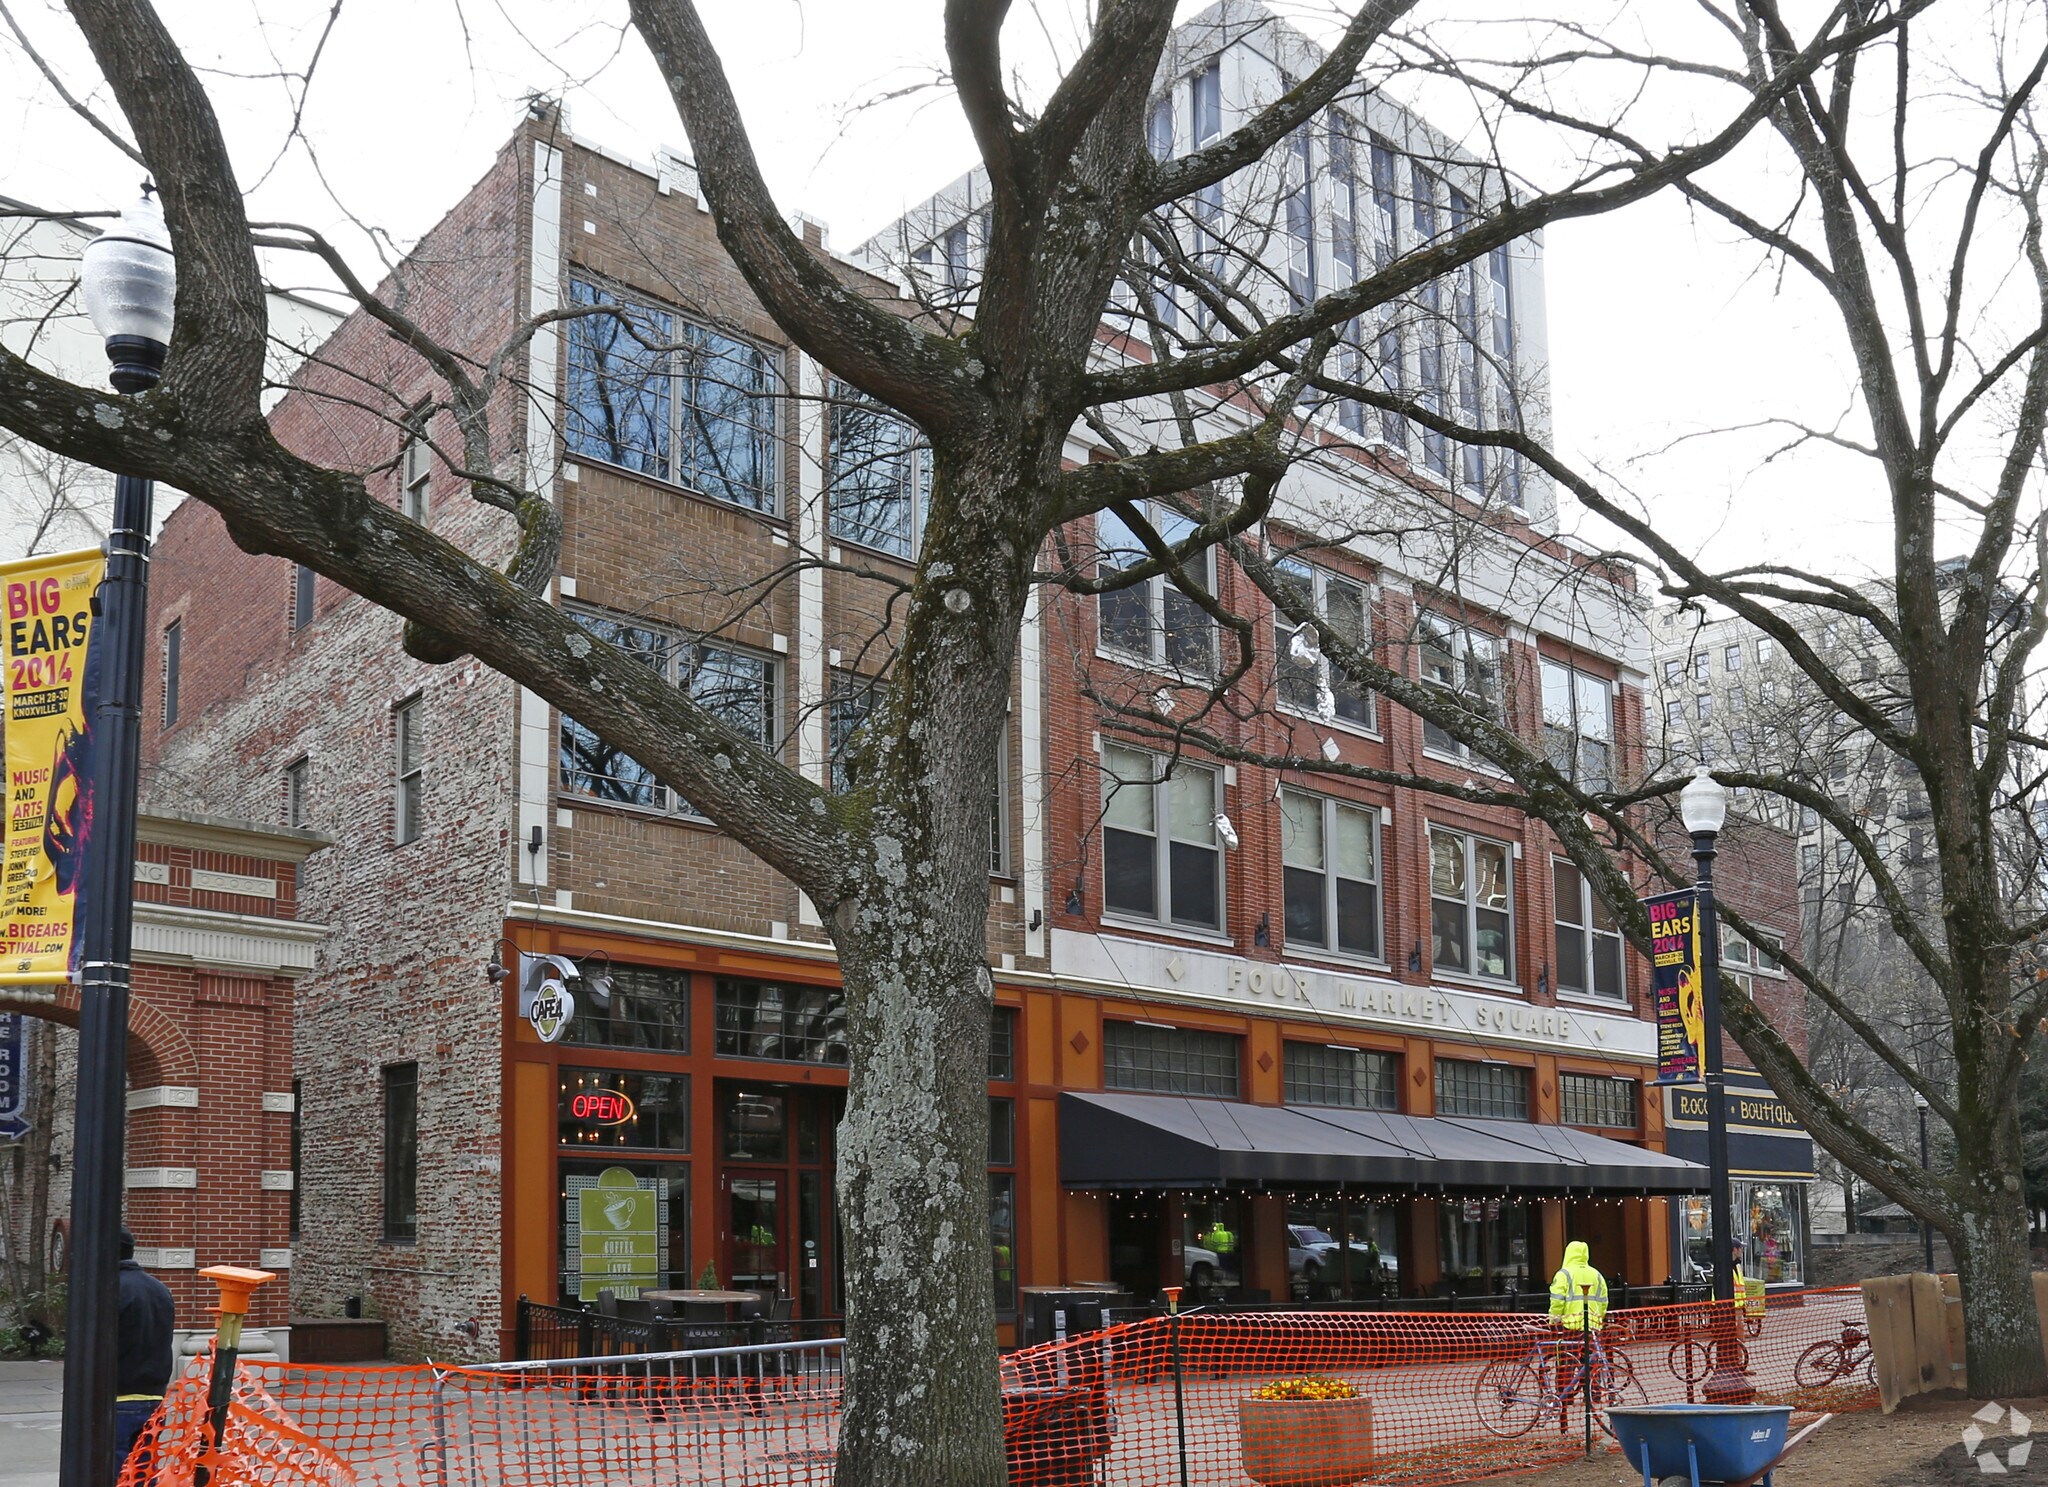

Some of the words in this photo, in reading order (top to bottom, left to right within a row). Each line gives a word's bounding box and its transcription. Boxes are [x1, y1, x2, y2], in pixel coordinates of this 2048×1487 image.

[7, 577, 61, 620] BIG
[10, 611, 88, 657] EARS
[11, 651, 73, 691] 2014
[14, 693, 46, 707] MARCH
[47, 689, 68, 703] 28-30
[14, 703, 59, 718] KNOXVILLE,
[59, 702, 68, 711] TN
[13, 767, 49, 786] MUSIC
[14, 787, 35, 801] AND
[13, 800, 43, 819] ARTS
[14, 816, 44, 831] FESTIVAL
[10, 848, 28, 859] STEVE
[8, 861, 27, 871] JONNY
[16, 906, 47, 916] MORE!
[1650, 901, 1677, 922] BIG
[1651, 916, 1691, 939] EARS
[1653, 935, 1685, 954] 2014
[1658, 987, 1677, 997] MUSIC
[1659, 995, 1670, 1003] AND
[1227, 964, 1309, 1003] FOUR
[1339, 982, 1451, 1022] MARKET
[1476, 1003, 1570, 1038] SQUARE
[1659, 1001, 1677, 1011] ARTS
[572, 1094, 626, 1119] OPEN
[604, 1241, 634, 1254] COFFEE
[607, 1263, 632, 1277] LATTE
